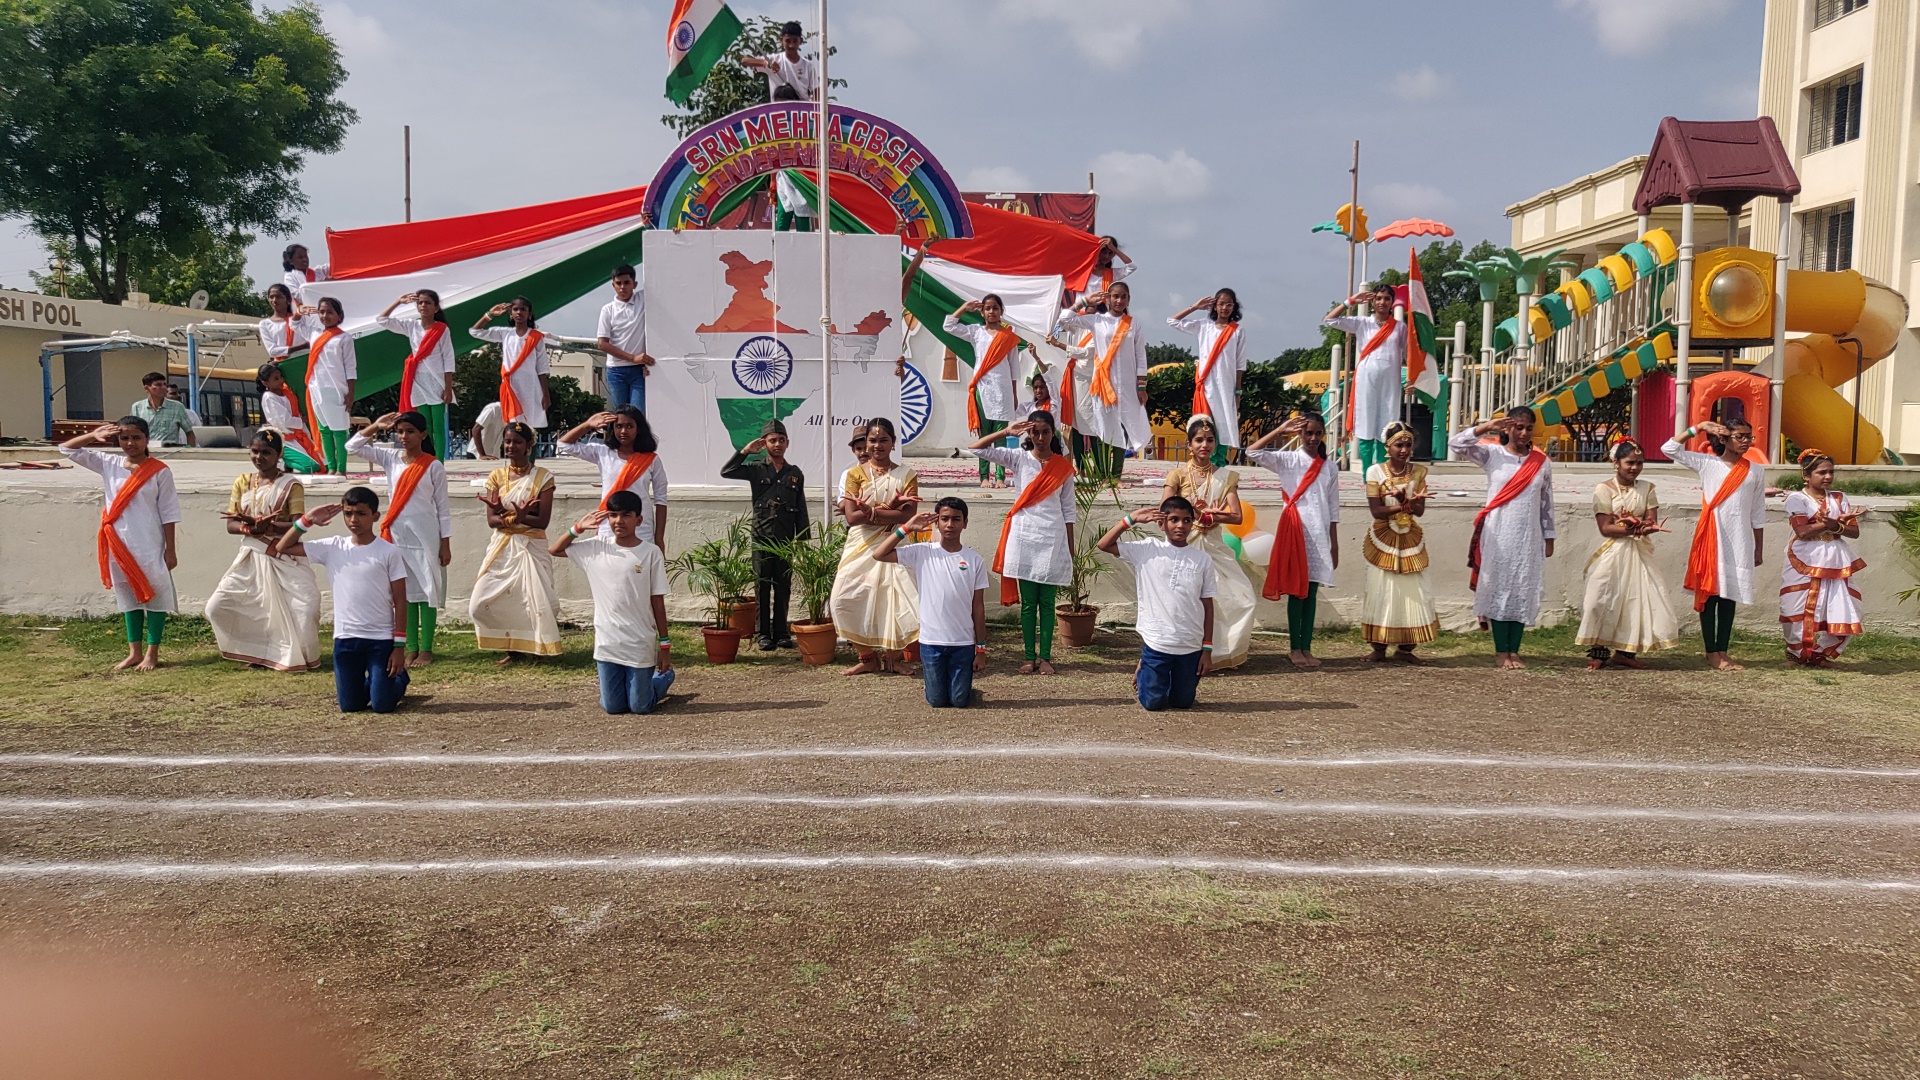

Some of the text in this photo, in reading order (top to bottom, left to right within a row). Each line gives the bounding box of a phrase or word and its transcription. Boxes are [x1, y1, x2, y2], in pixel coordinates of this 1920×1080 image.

[685, 110, 924, 179] SRN MEHTA CBSE
[890, 181, 930, 223] DAY
[32, 300, 82, 327] POOL
[804, 415, 823, 426] All
[852, 415, 870, 426] On
